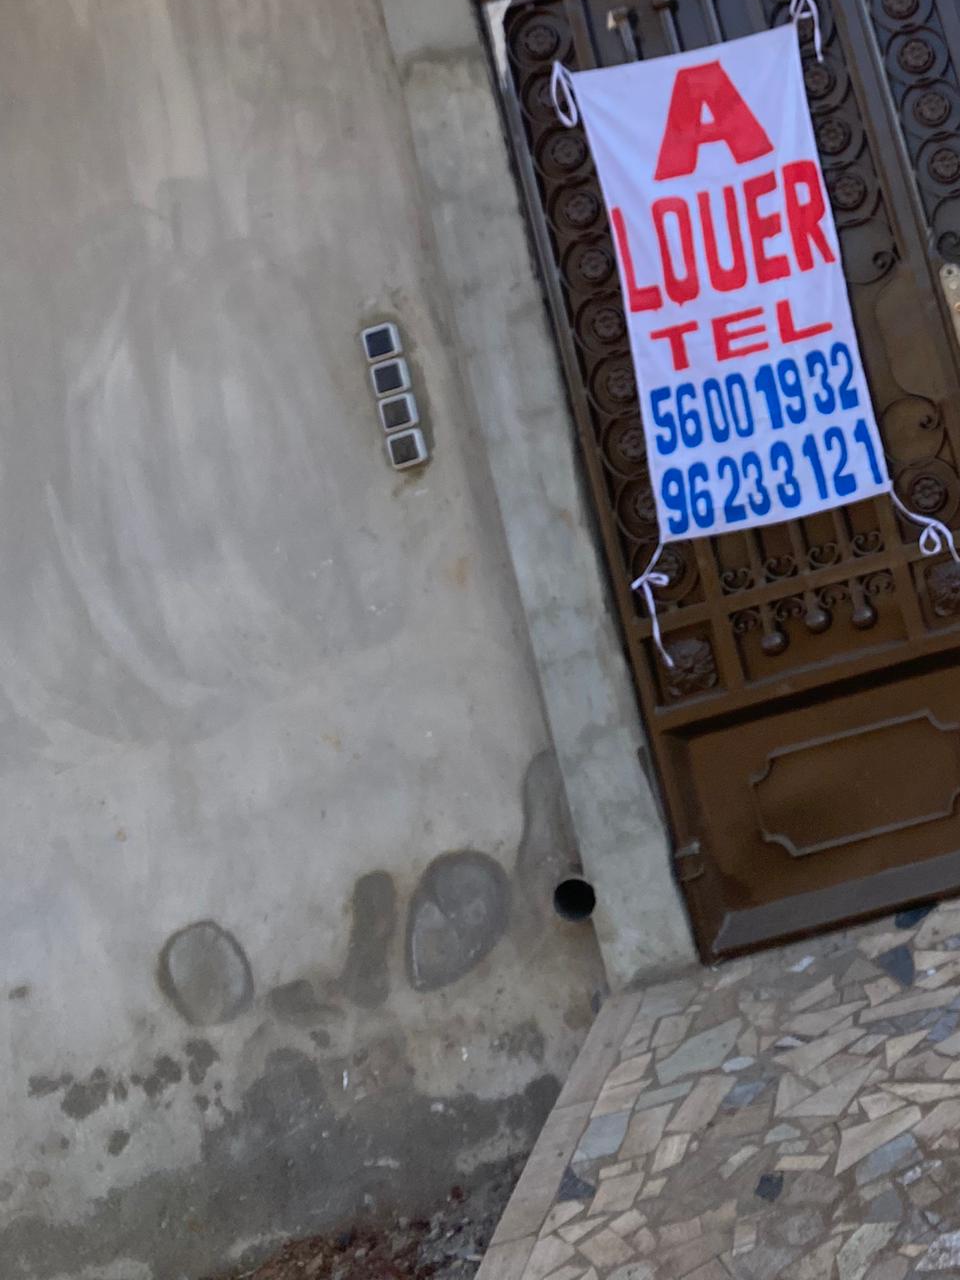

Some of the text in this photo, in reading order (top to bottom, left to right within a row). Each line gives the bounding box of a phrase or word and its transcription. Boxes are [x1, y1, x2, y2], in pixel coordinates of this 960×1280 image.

[655, 61, 773, 181] A
[610, 160, 835, 313] LOUER
[651, 300, 833, 371] TEL
